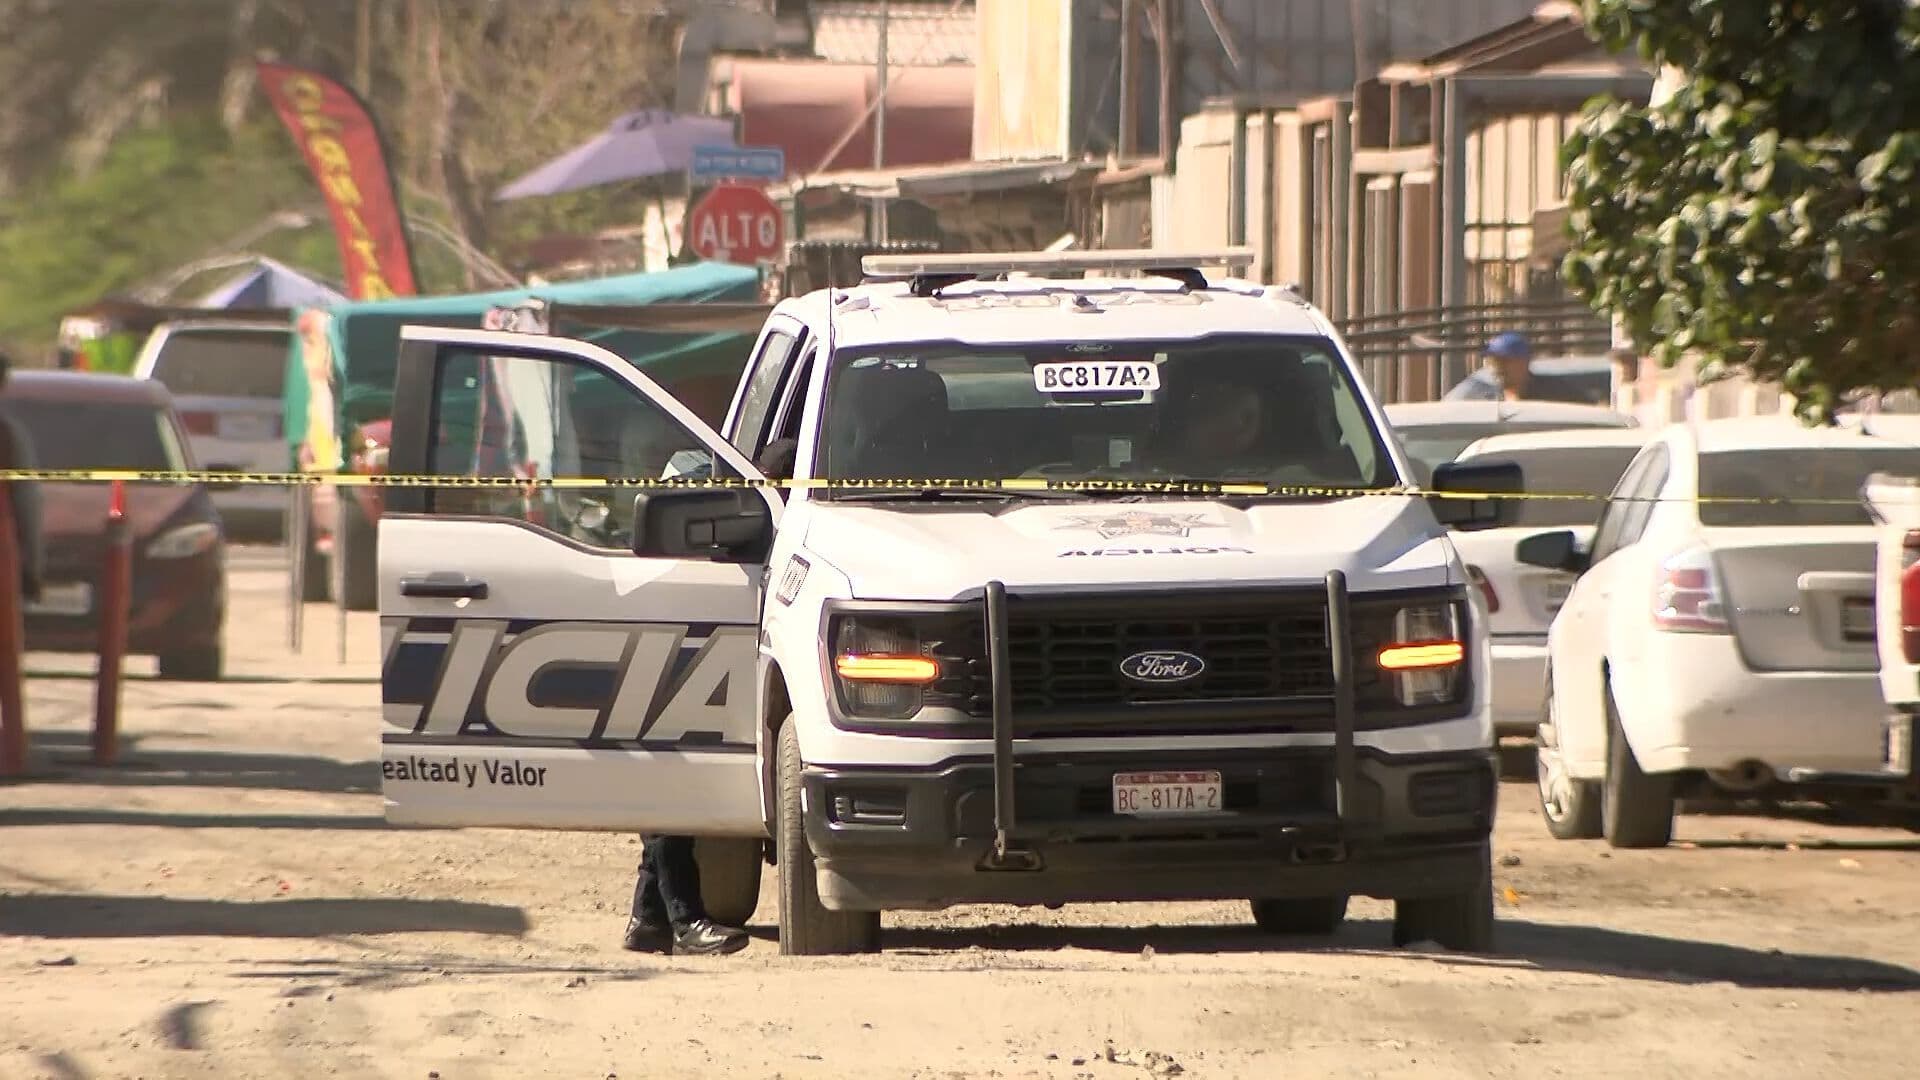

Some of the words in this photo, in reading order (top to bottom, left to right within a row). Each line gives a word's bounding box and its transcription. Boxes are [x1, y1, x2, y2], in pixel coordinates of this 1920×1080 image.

[700, 213, 777, 249] ALTO
[1043, 366, 1151, 388] BC817A2
[1136, 655, 1188, 677] Ford
[463, 763, 477, 788] y
[483, 759, 547, 786] Valor
[1118, 786, 1217, 811] BC-817A-2
